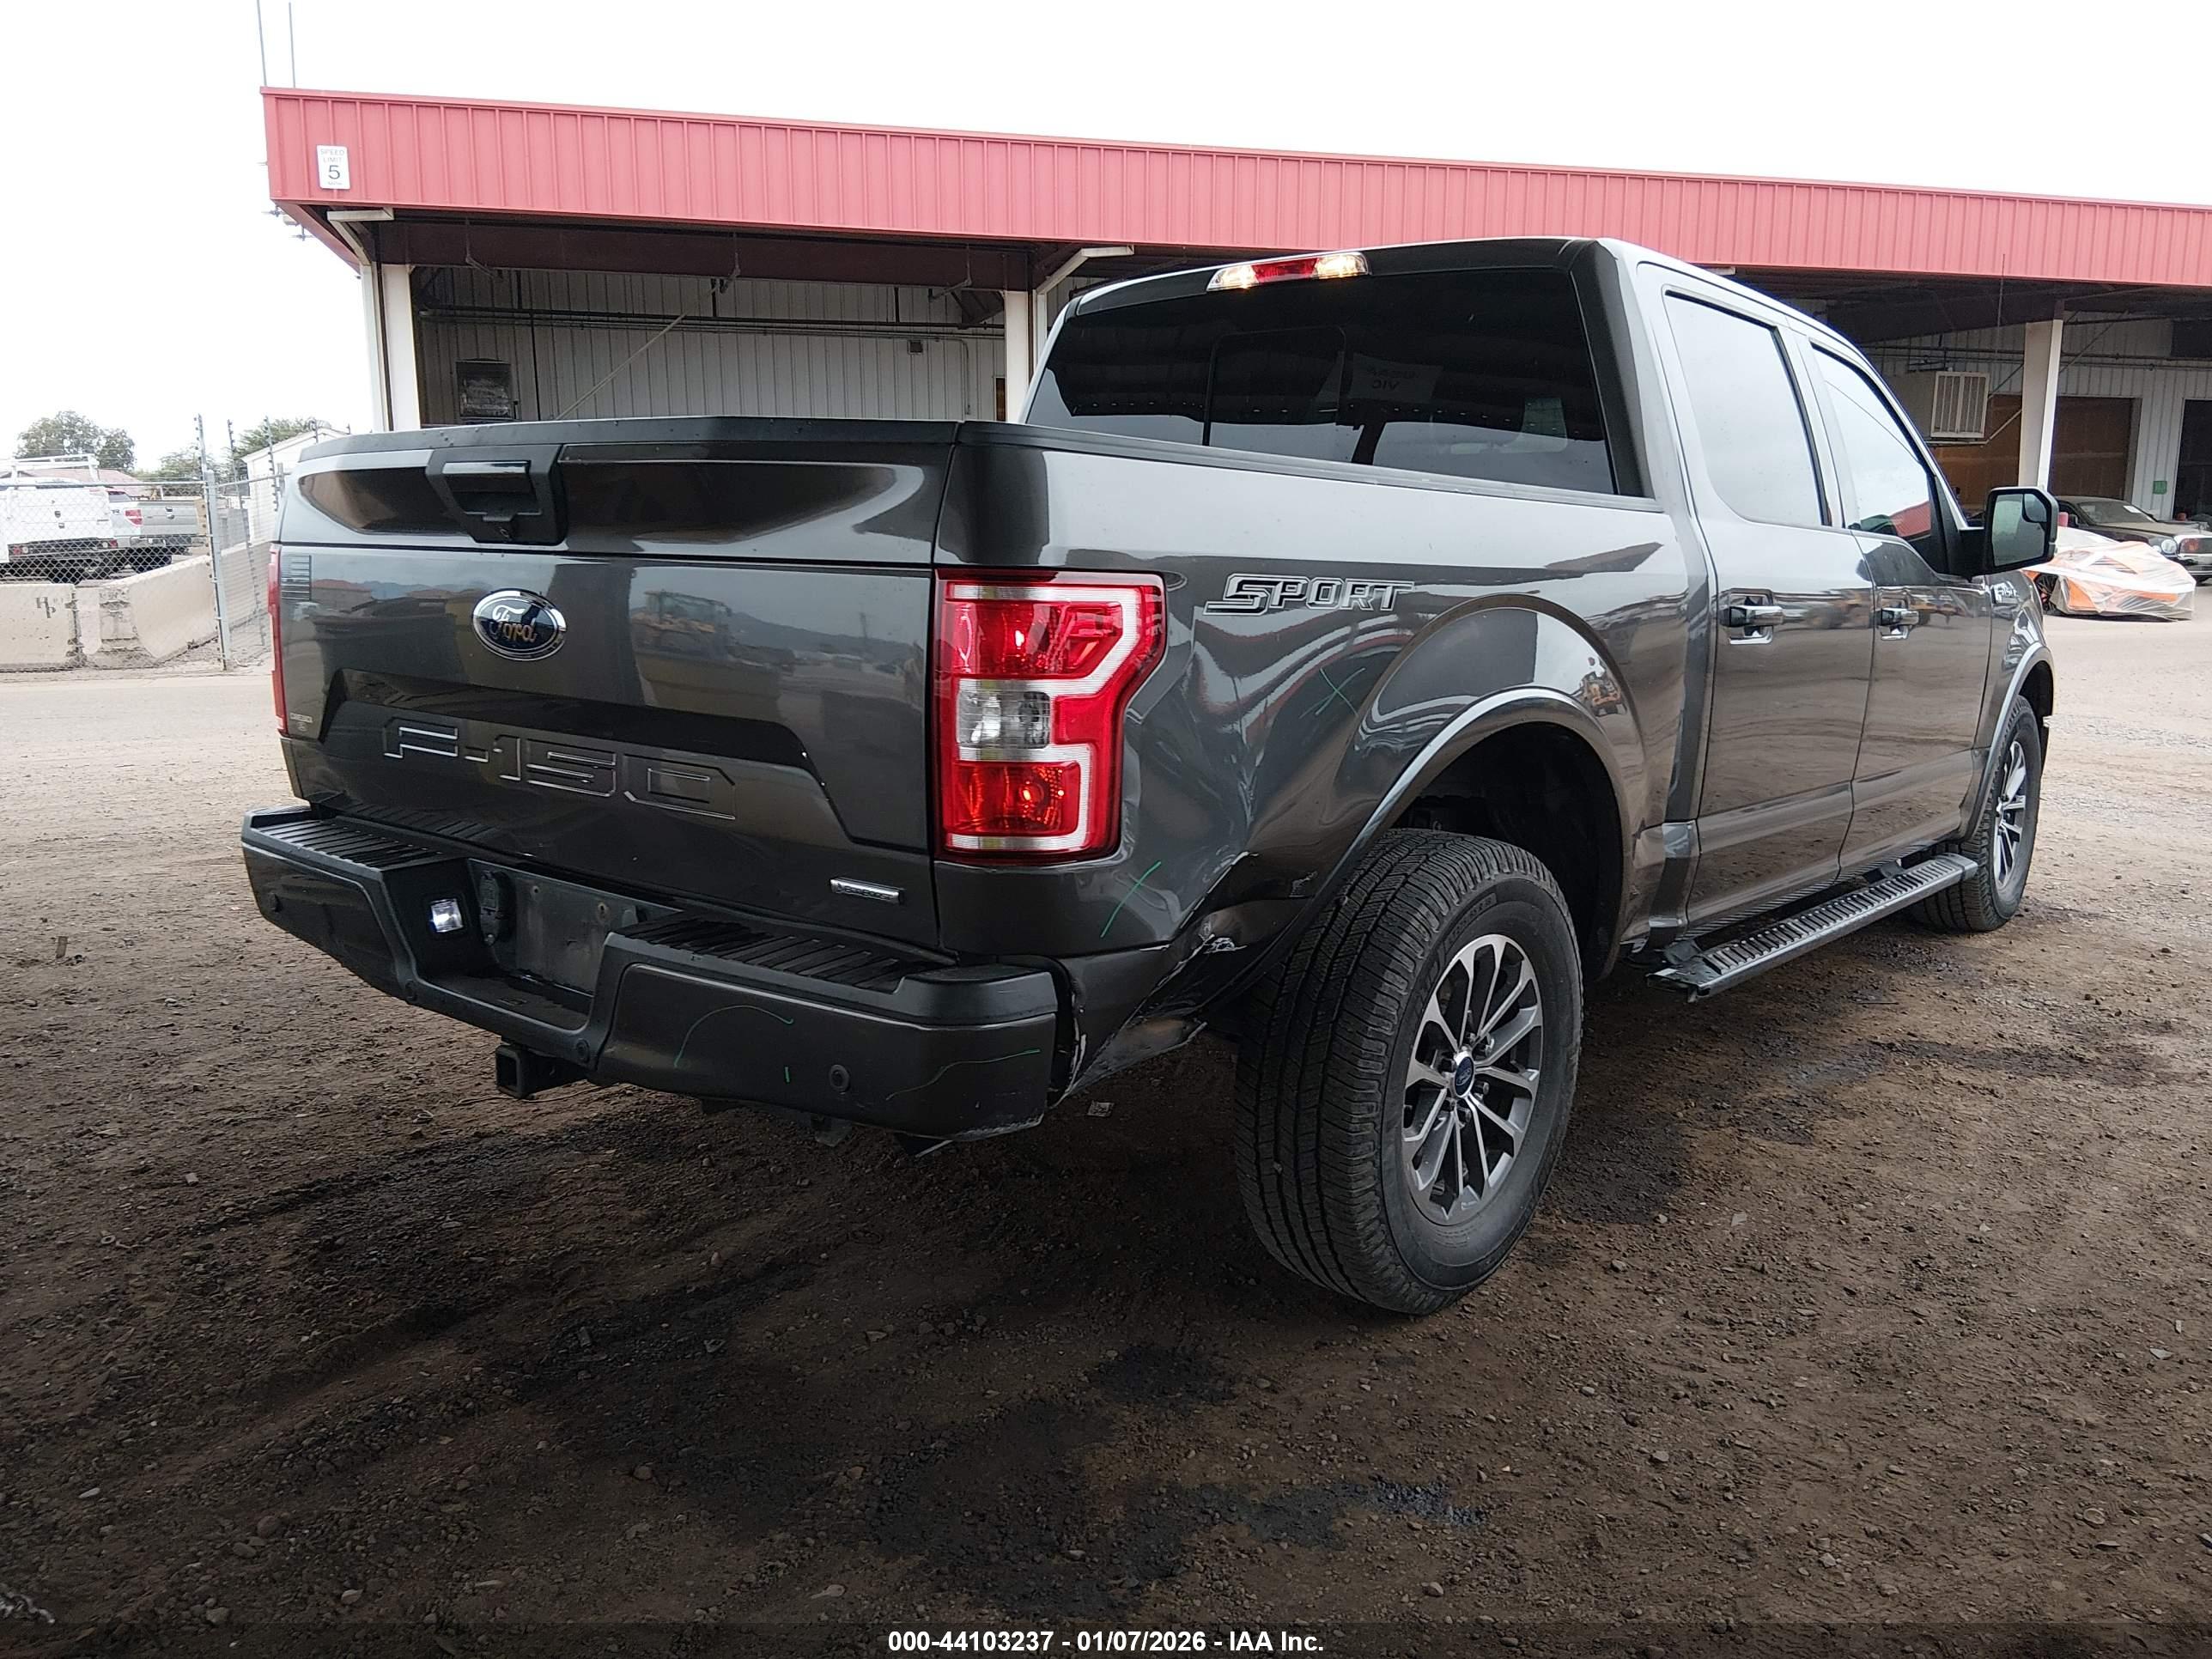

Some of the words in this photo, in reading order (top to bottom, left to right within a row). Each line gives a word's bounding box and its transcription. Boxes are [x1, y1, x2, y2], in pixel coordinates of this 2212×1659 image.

[328, 165, 340, 179] 5
[1203, 573, 1415, 616] SPORT
[383, 716, 736, 820] F-150
